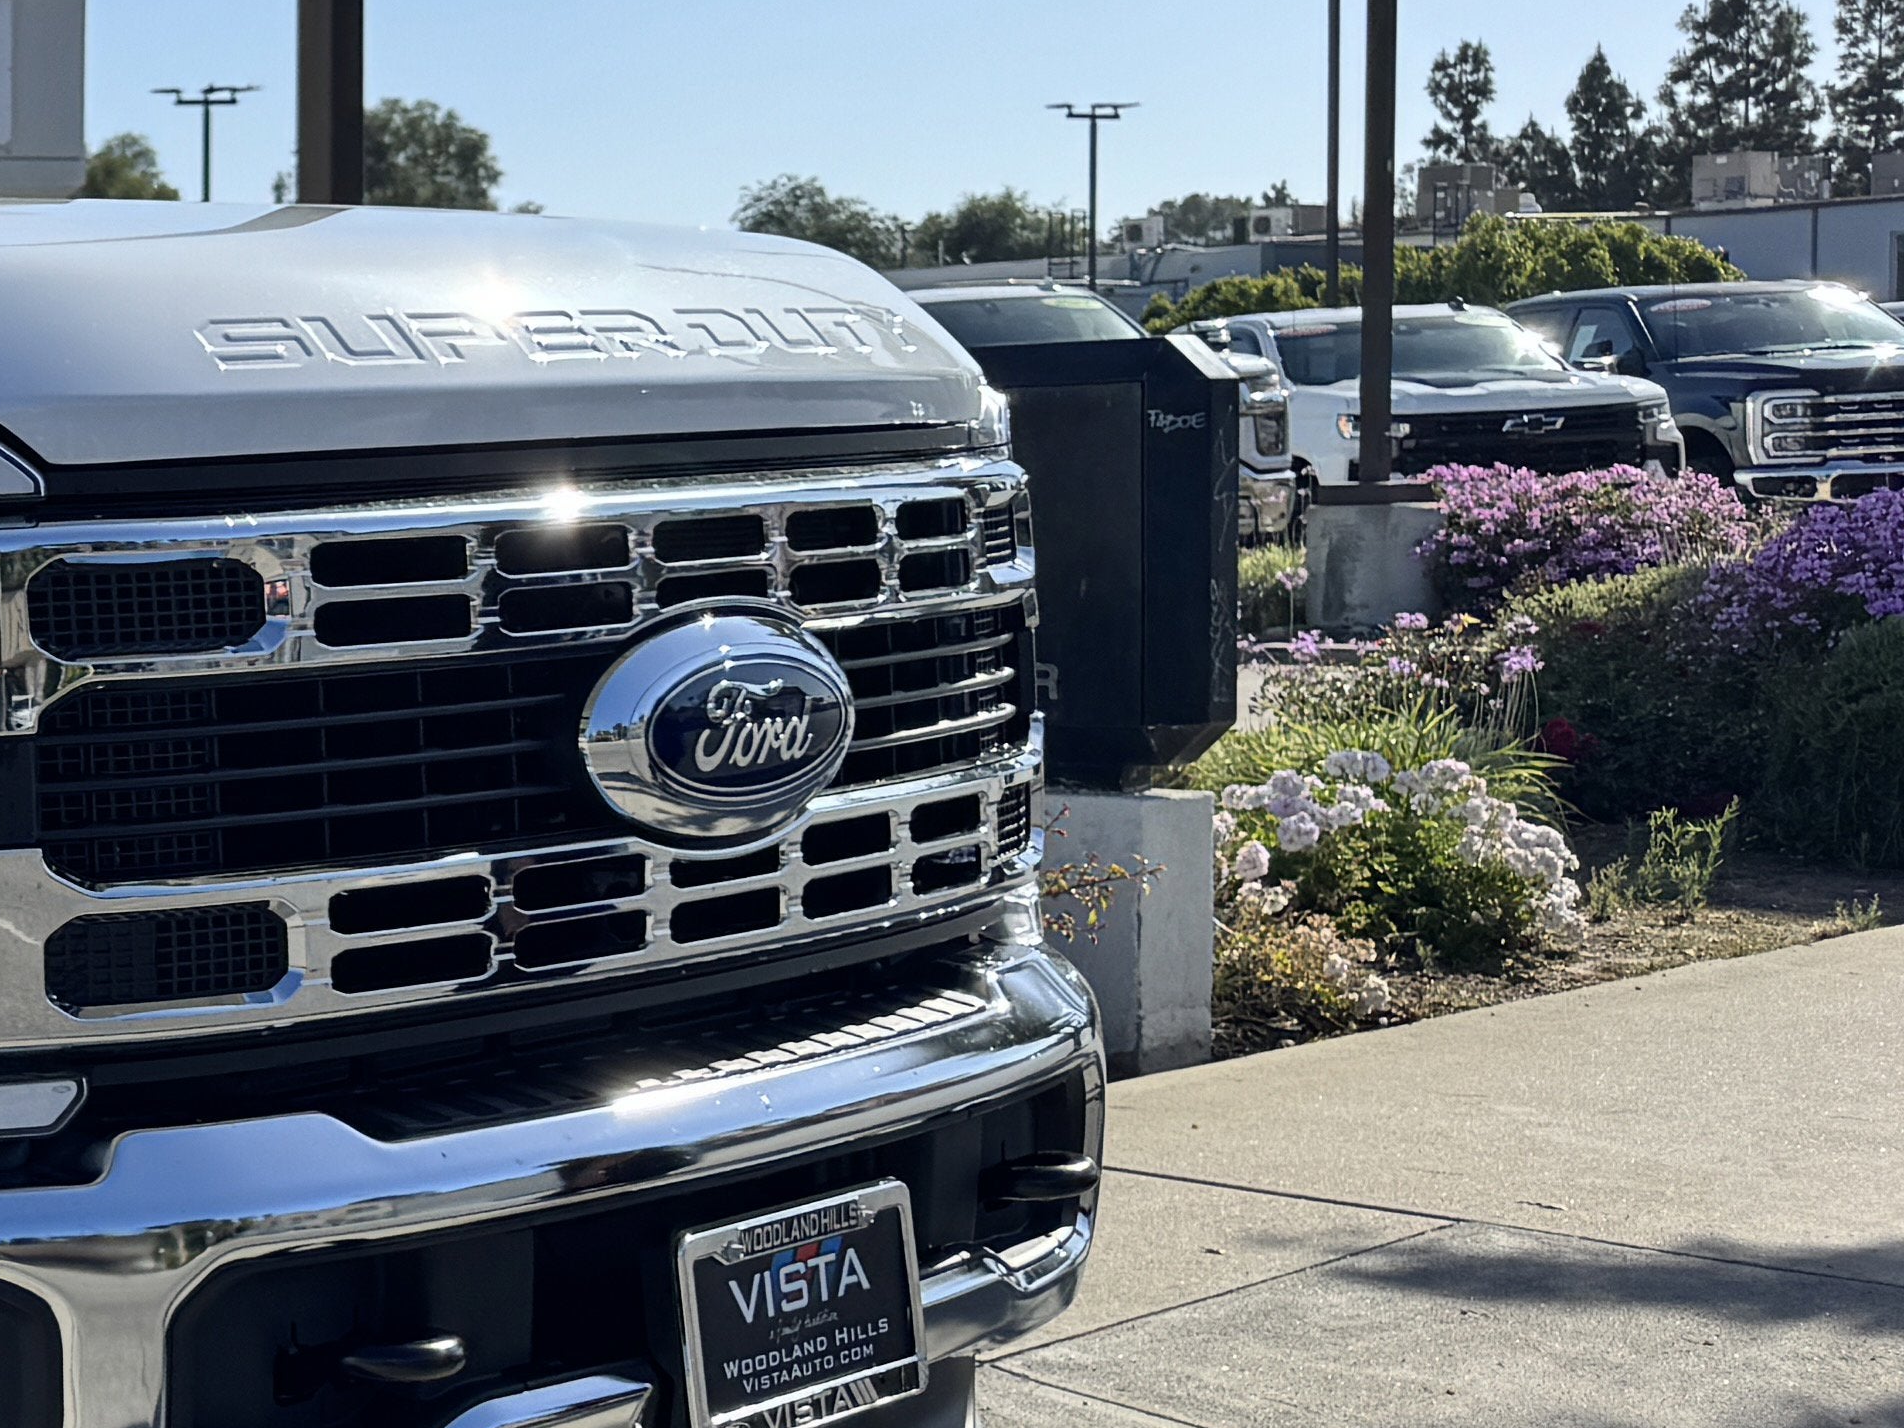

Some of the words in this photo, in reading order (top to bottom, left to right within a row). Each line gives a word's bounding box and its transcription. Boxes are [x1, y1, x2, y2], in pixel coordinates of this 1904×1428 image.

[192, 309, 689, 371] SUPER
[672, 306, 919, 358] DUTY
[695, 678, 814, 772] Ford
[742, 1213, 819, 1253] WOODLAND
[820, 1203, 859, 1235] HILLS
[728, 1248, 871, 1324] VISTA
[723, 1336, 828, 1379] WOODLAND
[835, 1318, 889, 1346] HILLS
